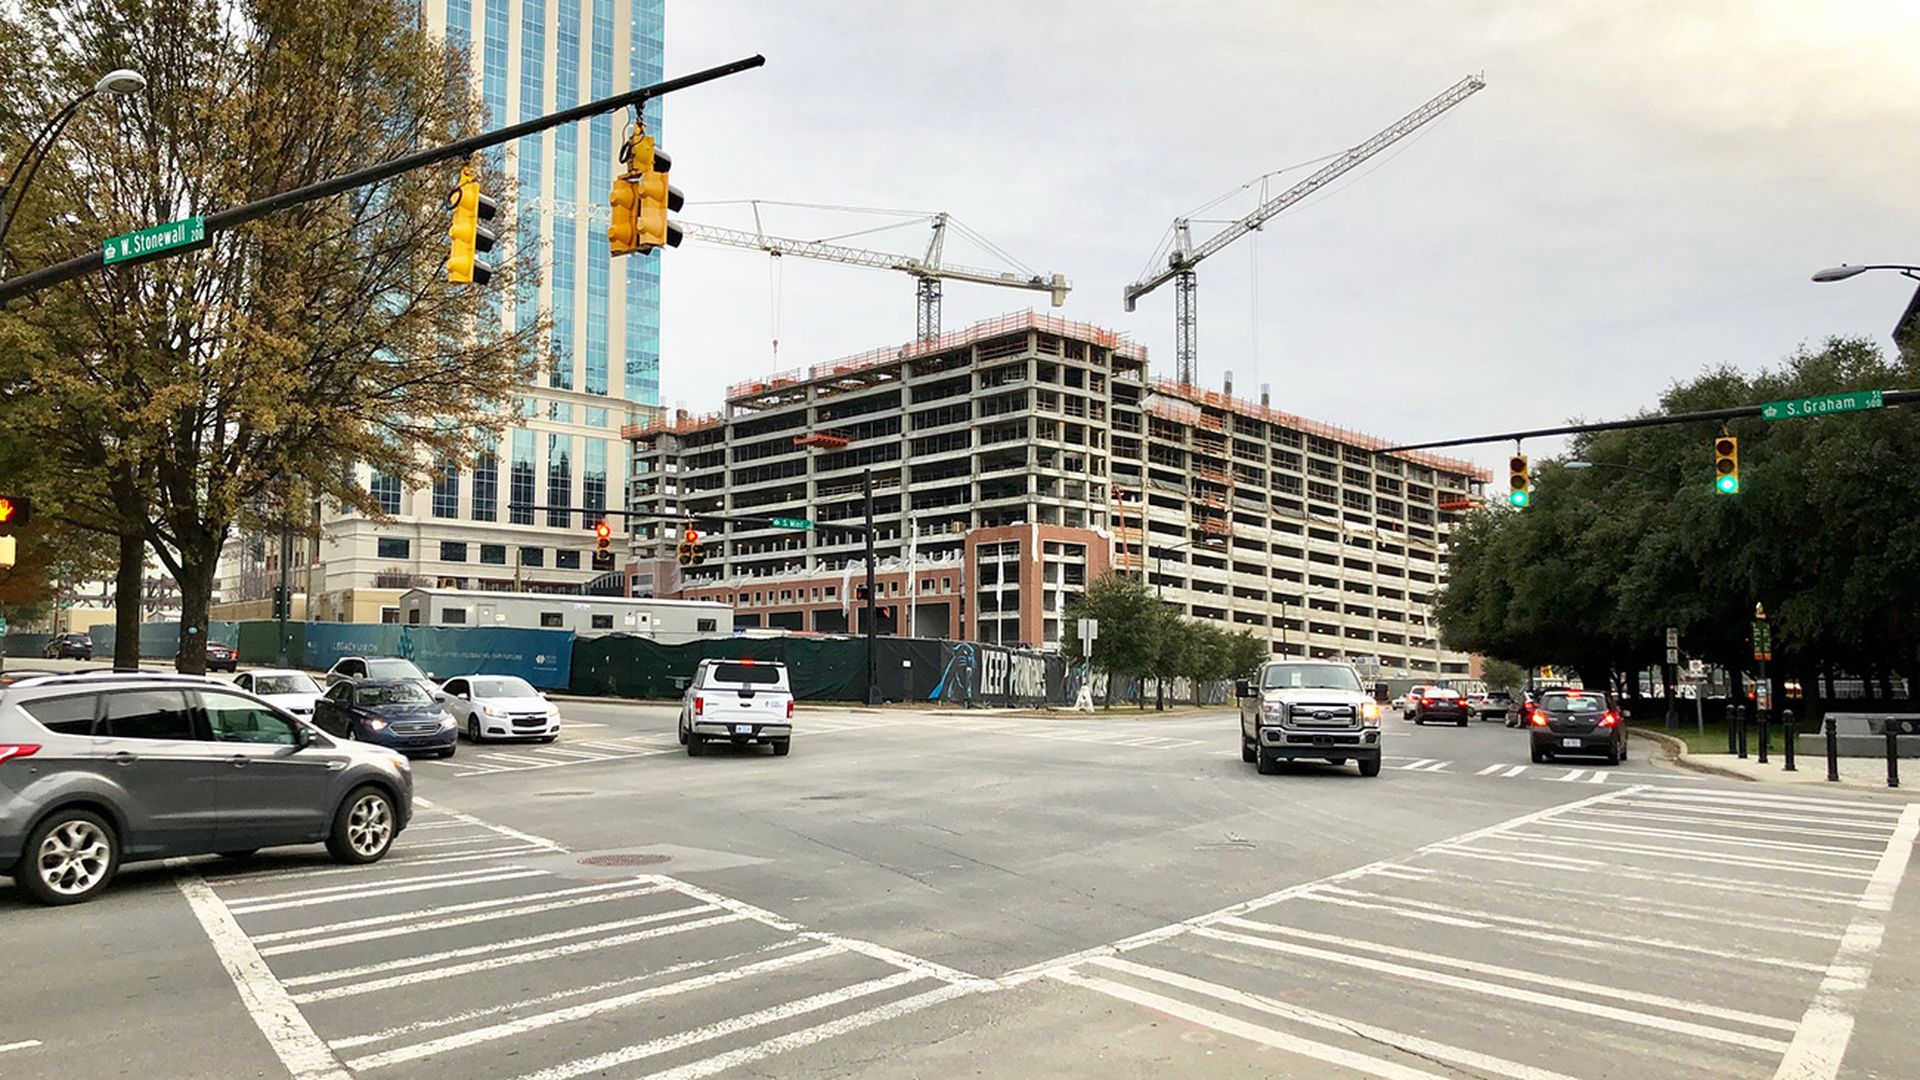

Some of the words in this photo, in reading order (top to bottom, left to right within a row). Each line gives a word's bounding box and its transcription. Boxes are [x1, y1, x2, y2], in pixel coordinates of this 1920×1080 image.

[121, 238, 132, 256] W.
[134, 223, 185, 254] Stonewall
[1787, 402, 1800, 416] S.
[1803, 397, 1855, 414] Graham
[981, 649, 1008, 695] KEEP
